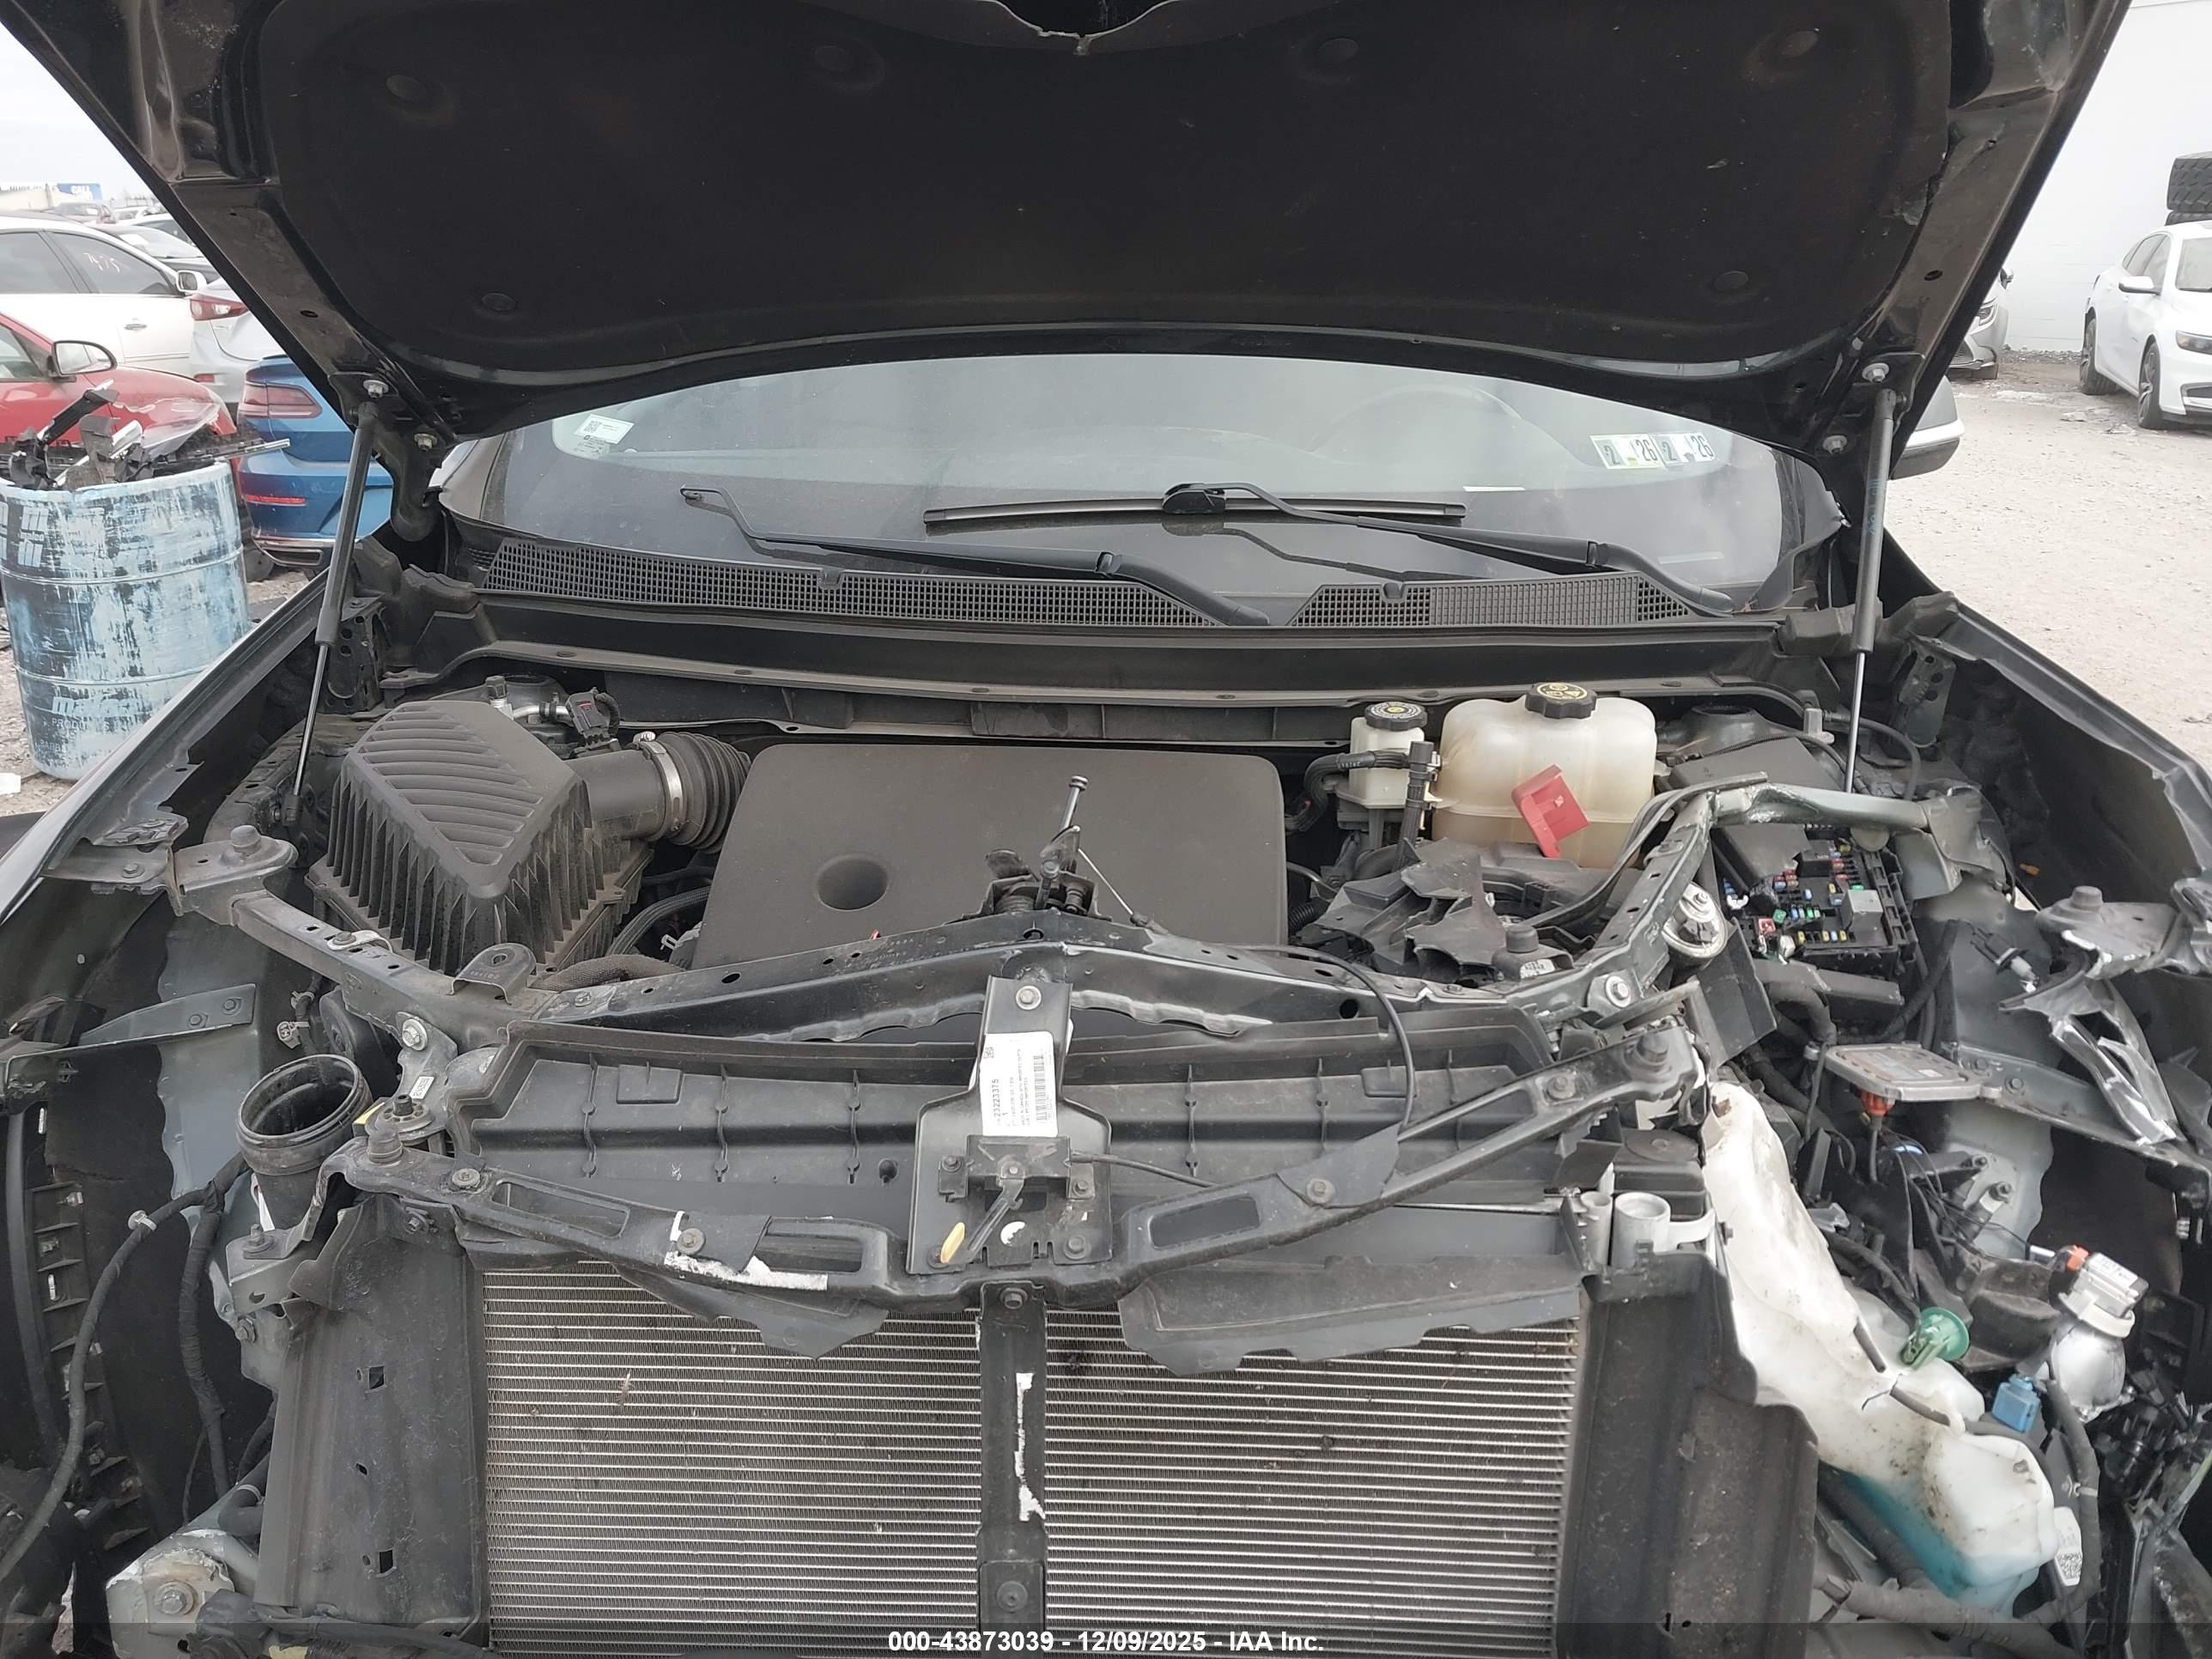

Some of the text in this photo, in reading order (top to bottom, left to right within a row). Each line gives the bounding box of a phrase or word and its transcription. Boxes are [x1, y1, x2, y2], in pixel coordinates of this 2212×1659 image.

[1604, 439, 1658, 465] 2 26
[1662, 434, 1714, 462] 2 26
[992, 1079, 1000, 1118] 23223375
